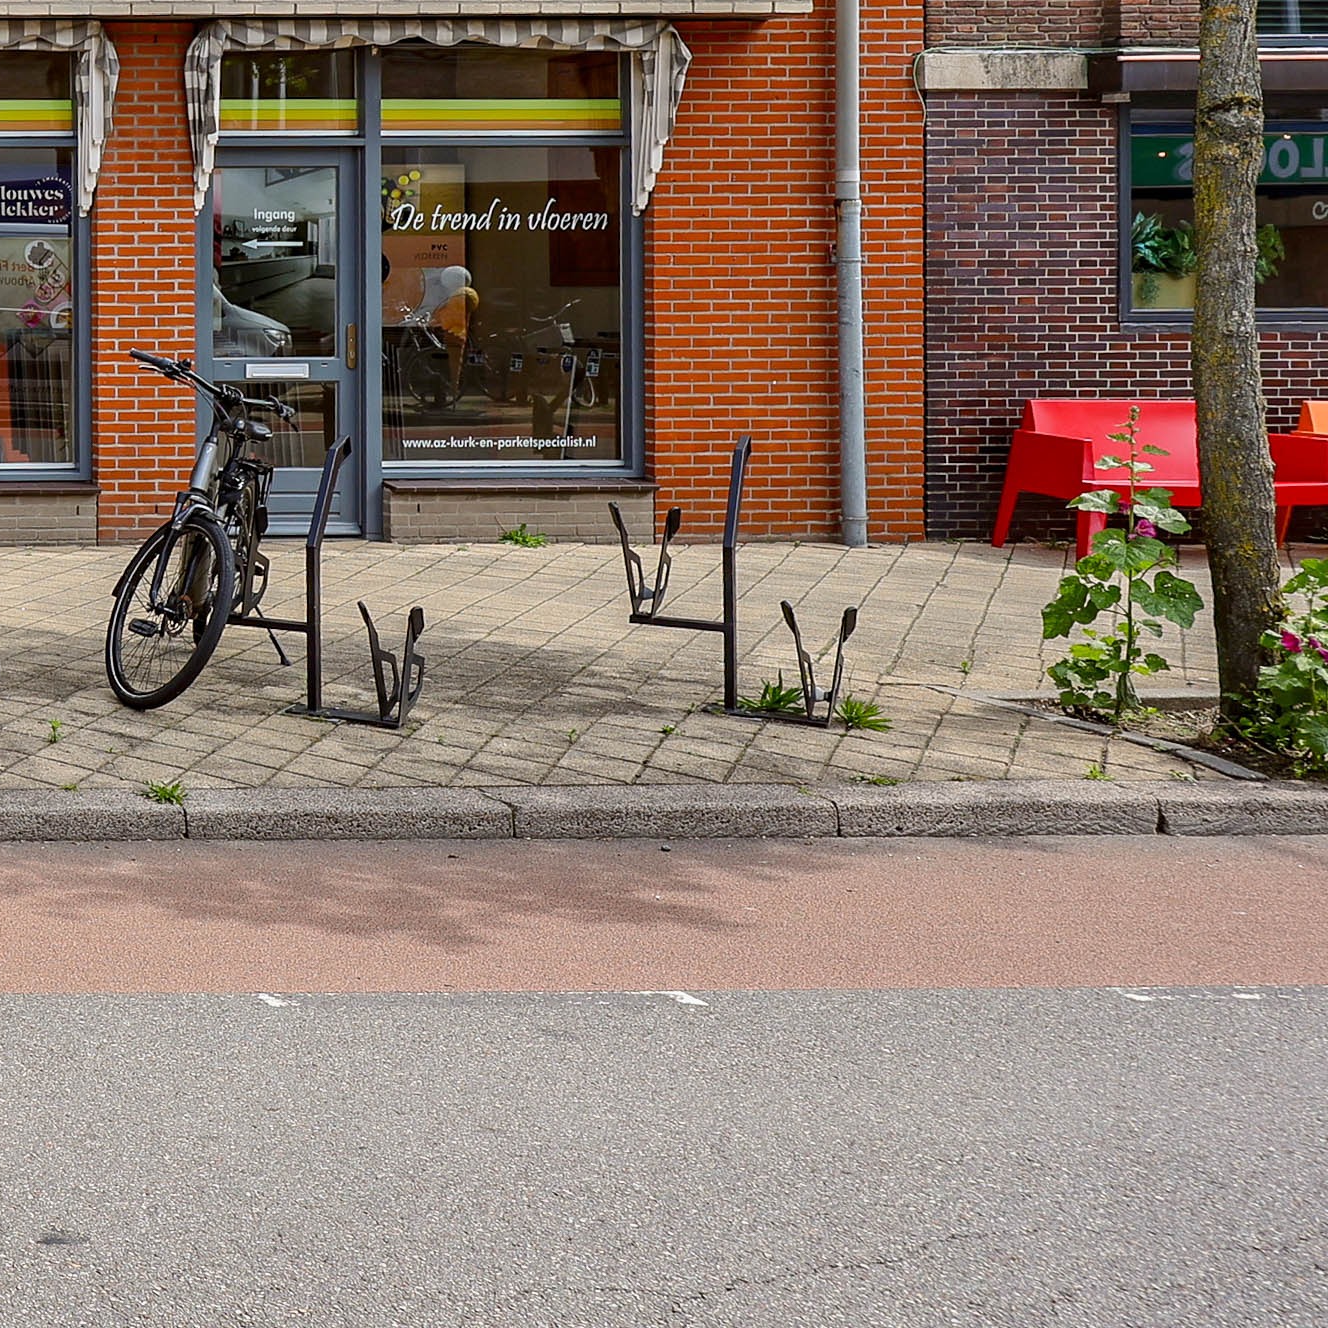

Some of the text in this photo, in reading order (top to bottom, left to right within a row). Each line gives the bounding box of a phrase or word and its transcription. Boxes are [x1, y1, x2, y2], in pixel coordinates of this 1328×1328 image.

[253, 207, 296, 223] Ingang
[390, 197, 609, 231] De trend in vloeren
[251, 225, 298, 233] volgende deur
[431, 243, 449, 252] PVC
[402, 435, 597, 450] www.az-kurk-en-parketspecialist.nl
